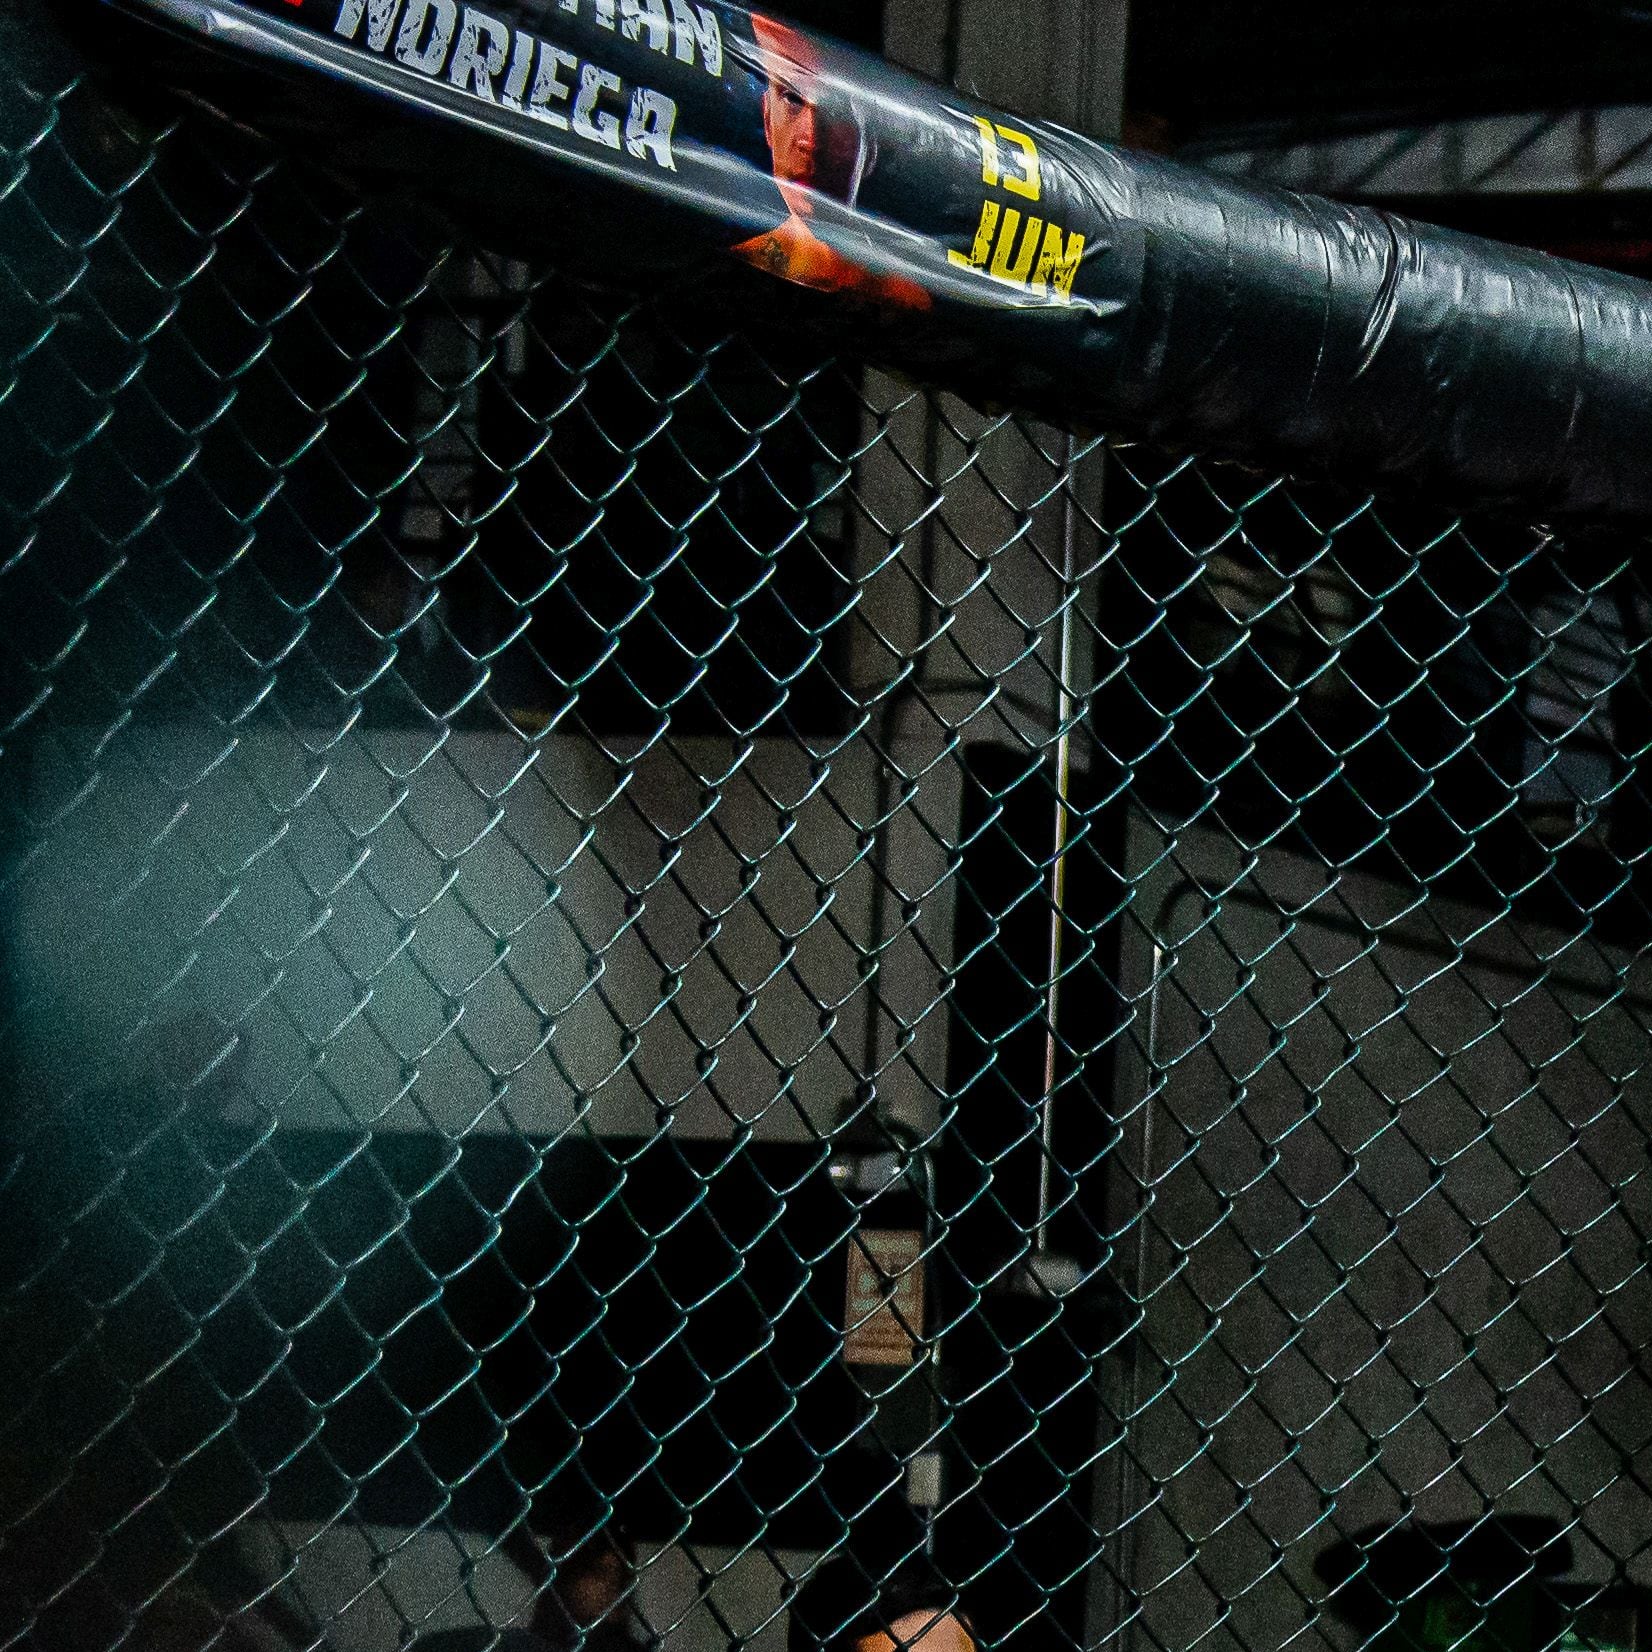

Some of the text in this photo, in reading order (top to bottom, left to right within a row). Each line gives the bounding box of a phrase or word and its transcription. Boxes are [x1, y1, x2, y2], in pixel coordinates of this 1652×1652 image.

[334, 0, 677, 172] NORIEGA
[974, 115, 1041, 200] 13
[948, 200, 1085, 304] JUN
